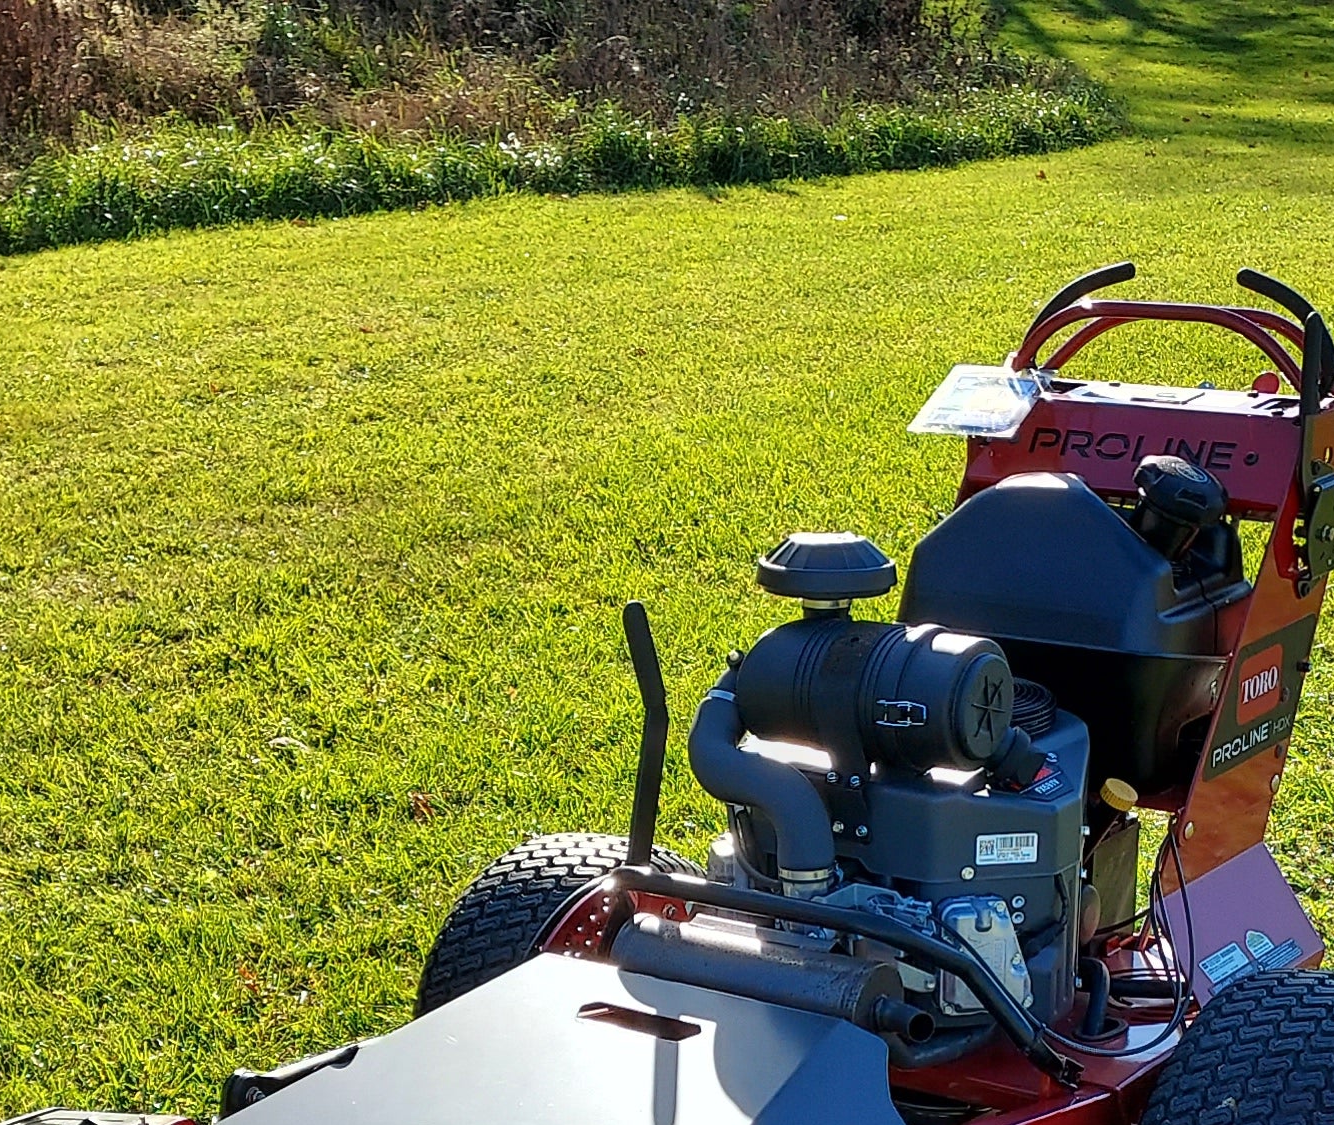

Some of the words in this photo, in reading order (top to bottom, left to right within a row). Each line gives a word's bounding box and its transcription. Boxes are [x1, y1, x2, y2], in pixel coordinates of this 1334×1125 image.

[1028, 427, 1238, 470] PROLINE
[1241, 665, 1279, 704] TORO
[1272, 714, 1291, 735] HDX
